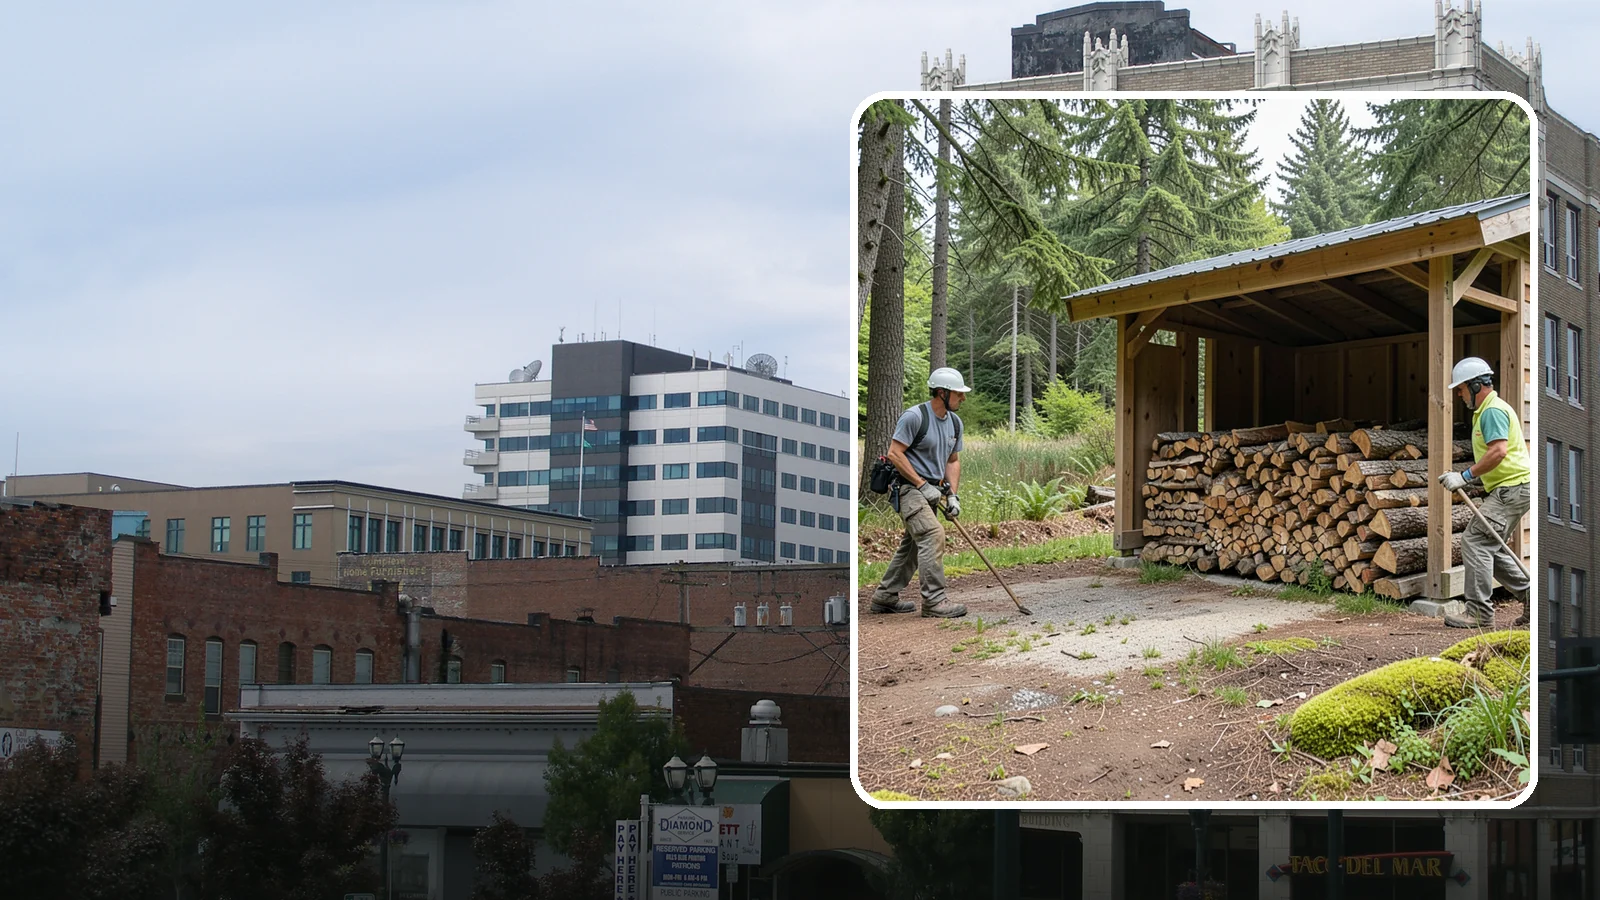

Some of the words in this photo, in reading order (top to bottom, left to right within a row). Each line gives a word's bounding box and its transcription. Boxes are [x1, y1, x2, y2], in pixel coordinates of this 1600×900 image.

[343, 568, 367, 577] Home
[660, 818, 713, 833] DIAMOND
[1022, 815, 1070, 828] BUILDING
[617, 825, 625, 852] PAY
[628, 824, 637, 852] PAY
[655, 845, 688, 853] RESERVED
[689, 846, 716, 854] PARKING
[721, 851, 739, 862] Soup
[671, 862, 701, 870] PATRONS
[1346, 856, 1385, 875] DEL
[1392, 857, 1442, 876] MAR
[616, 856, 625, 893] HERE
[627, 856, 636, 893] HERE
[660, 889, 682, 897] PUBLIC
[683, 890, 710, 898] PARKING
